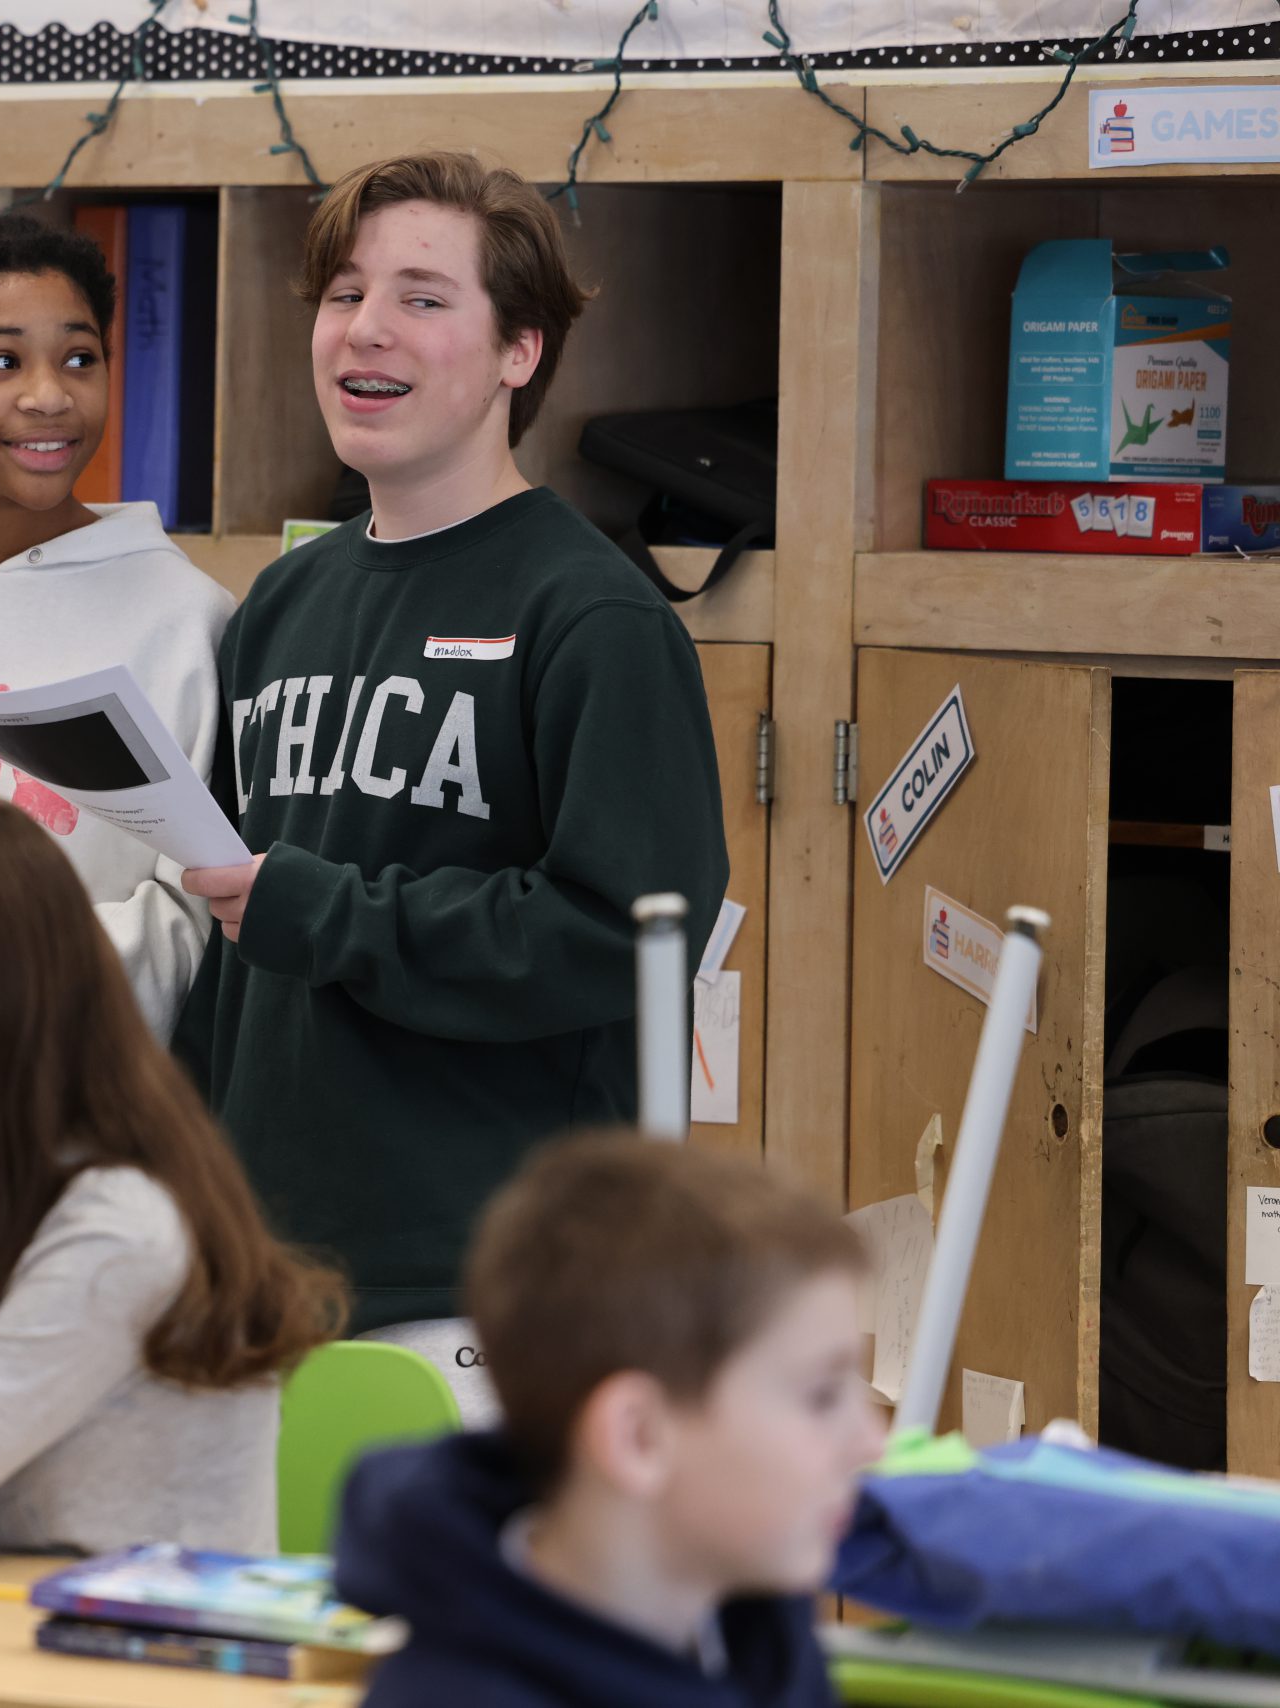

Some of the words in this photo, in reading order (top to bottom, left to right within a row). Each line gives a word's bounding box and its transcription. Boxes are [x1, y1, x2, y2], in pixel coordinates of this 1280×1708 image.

[1151, 107, 1280, 142] GAMES
[1023, 321, 1066, 333] ORIGAMI
[1067, 322, 1099, 333] PAPER
[1135, 370, 1175, 390] ORIGAMI
[1177, 372, 1207, 392] PAPER
[1199, 406, 1221, 419] 1100
[935, 489, 1065, 523] Rummikub
[1078, 501, 1090, 517] 5
[1098, 500, 1109, 517] 6
[1114, 502, 1126, 519] 7
[1135, 502, 1148, 522] 8
[969, 516, 1017, 528] CLASSIC
[901, 732, 951, 812] COLIN
